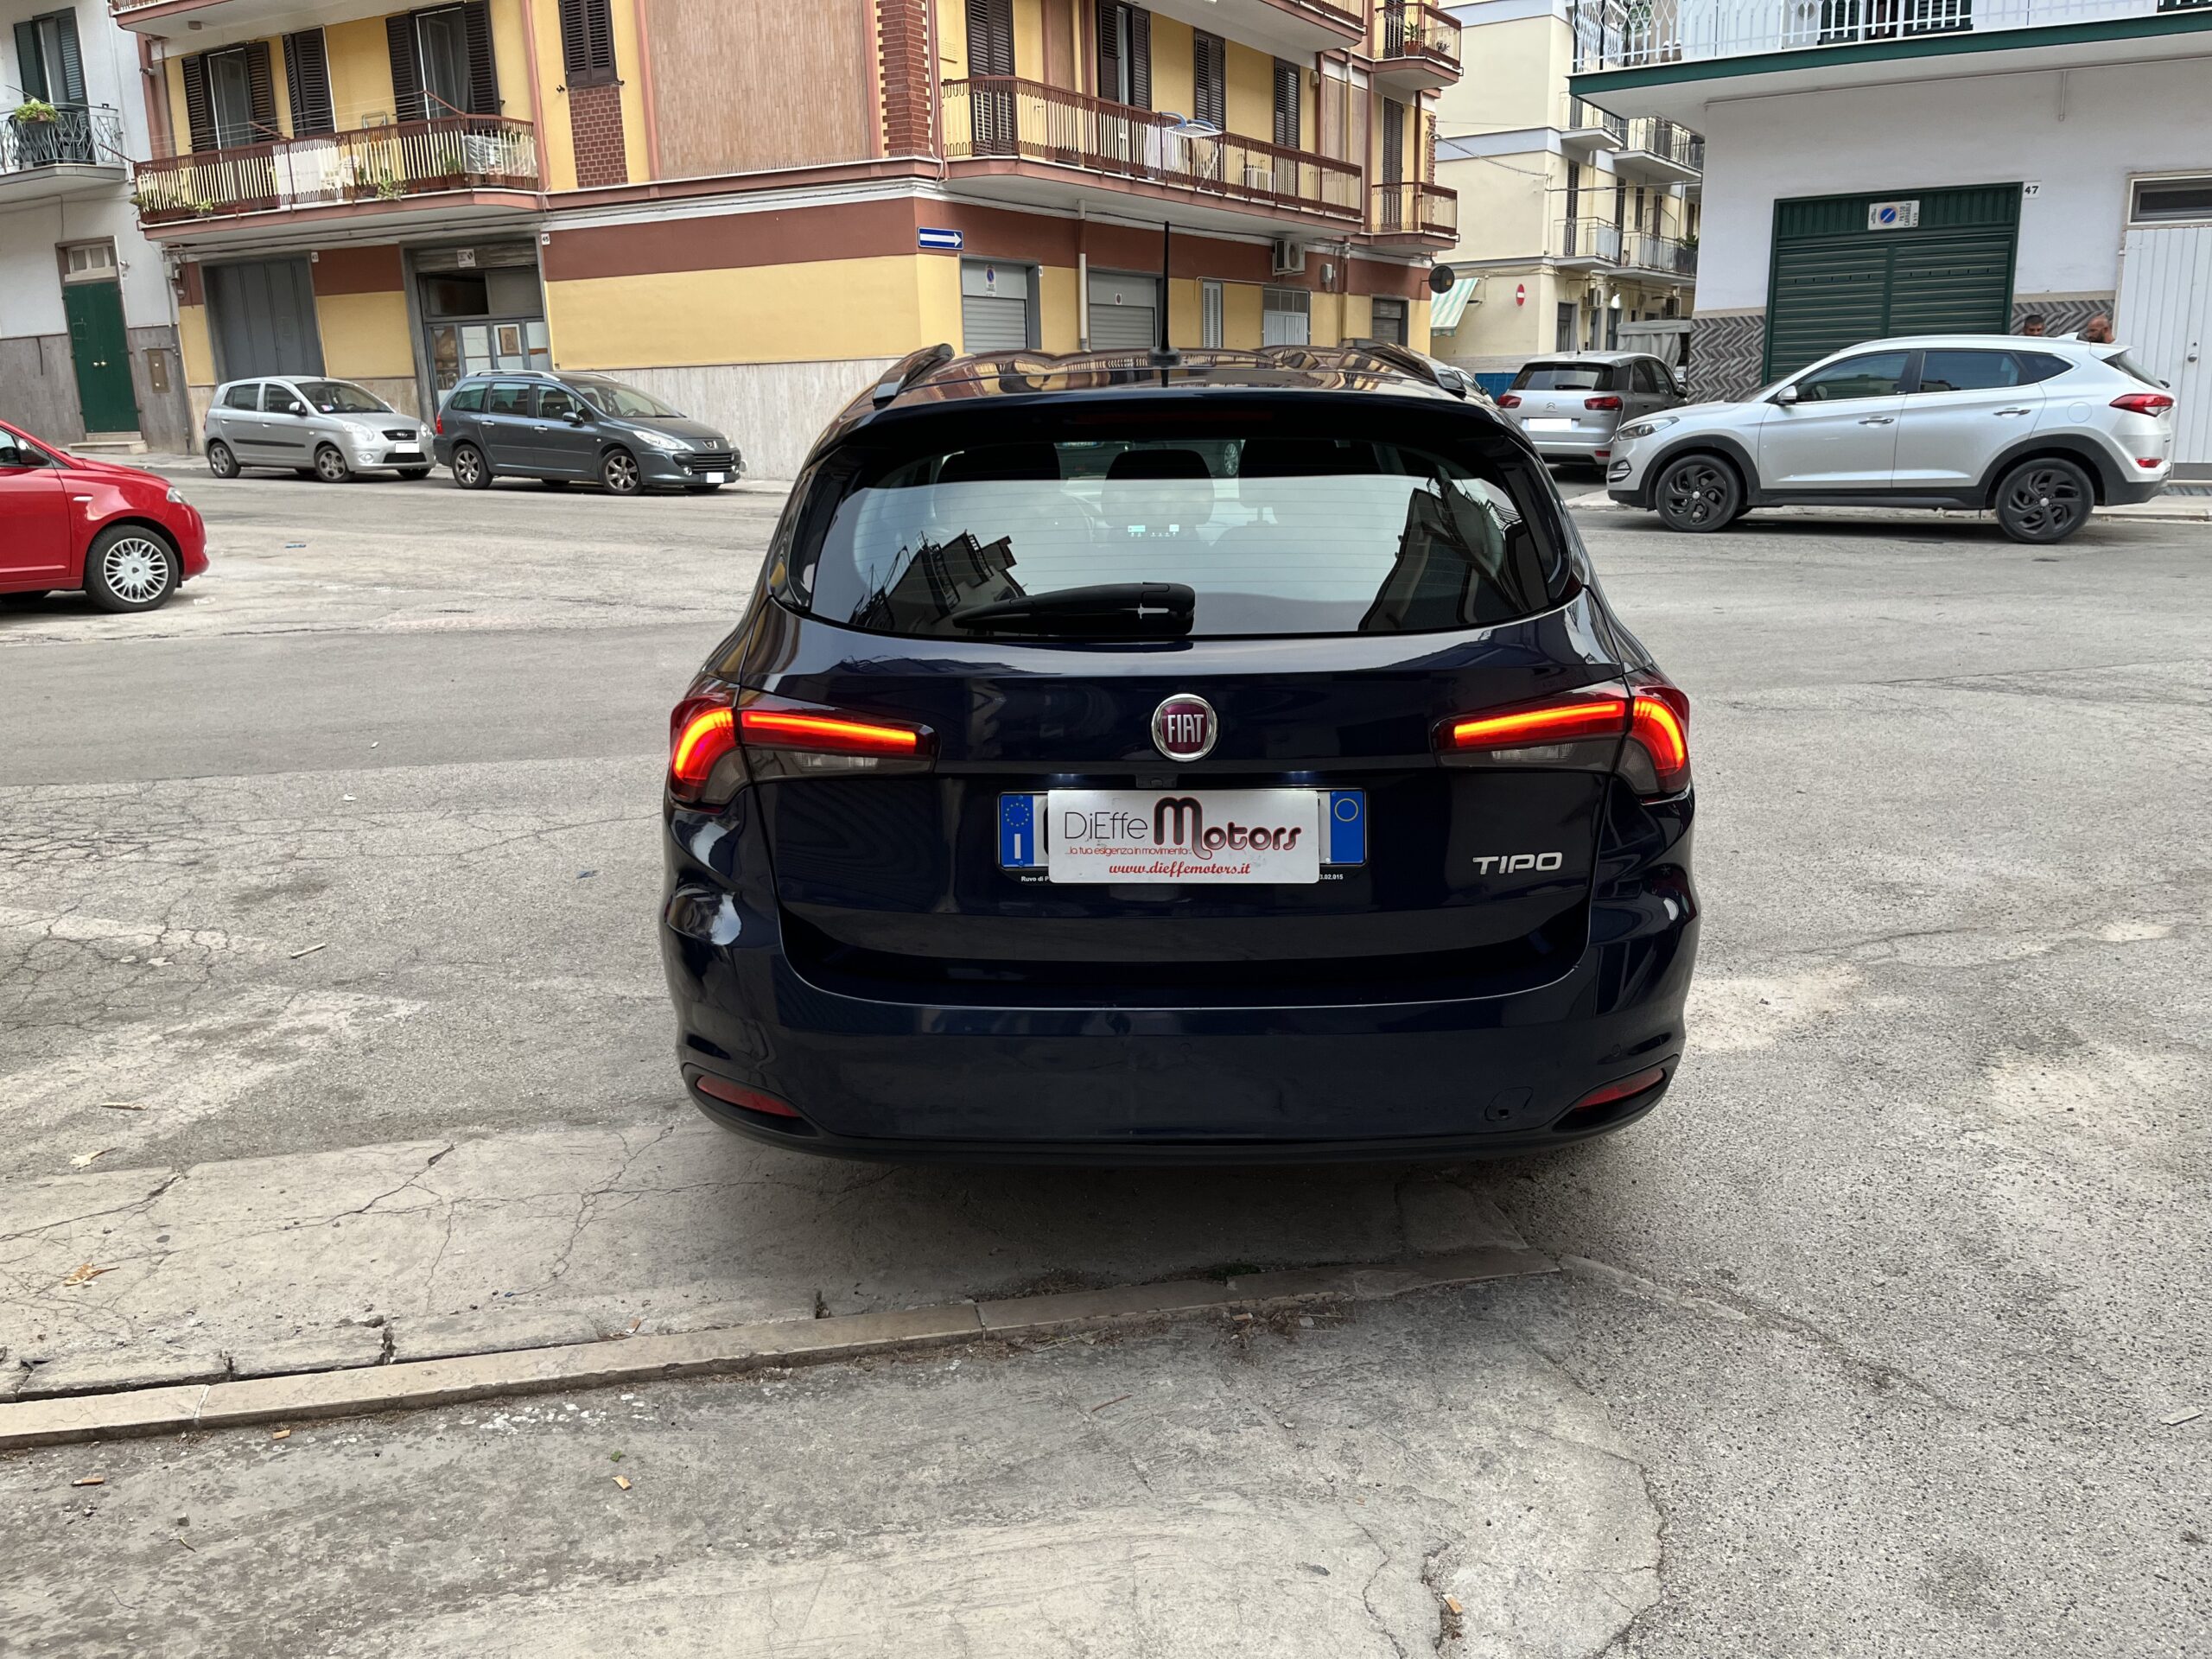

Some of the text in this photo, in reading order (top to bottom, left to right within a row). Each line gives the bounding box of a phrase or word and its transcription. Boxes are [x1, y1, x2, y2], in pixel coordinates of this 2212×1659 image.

[2024, 186, 2039, 194] 47
[1167, 714, 1205, 743] FIAT
[1065, 811, 1148, 840] DiEffe
[1079, 846, 1093, 855] tua
[1094, 846, 1133, 857] esigenza
[1134, 846, 1141, 855] in
[1109, 861, 1251, 878] www.dieffemotors.it
[1472, 852, 1562, 875] TIPO
